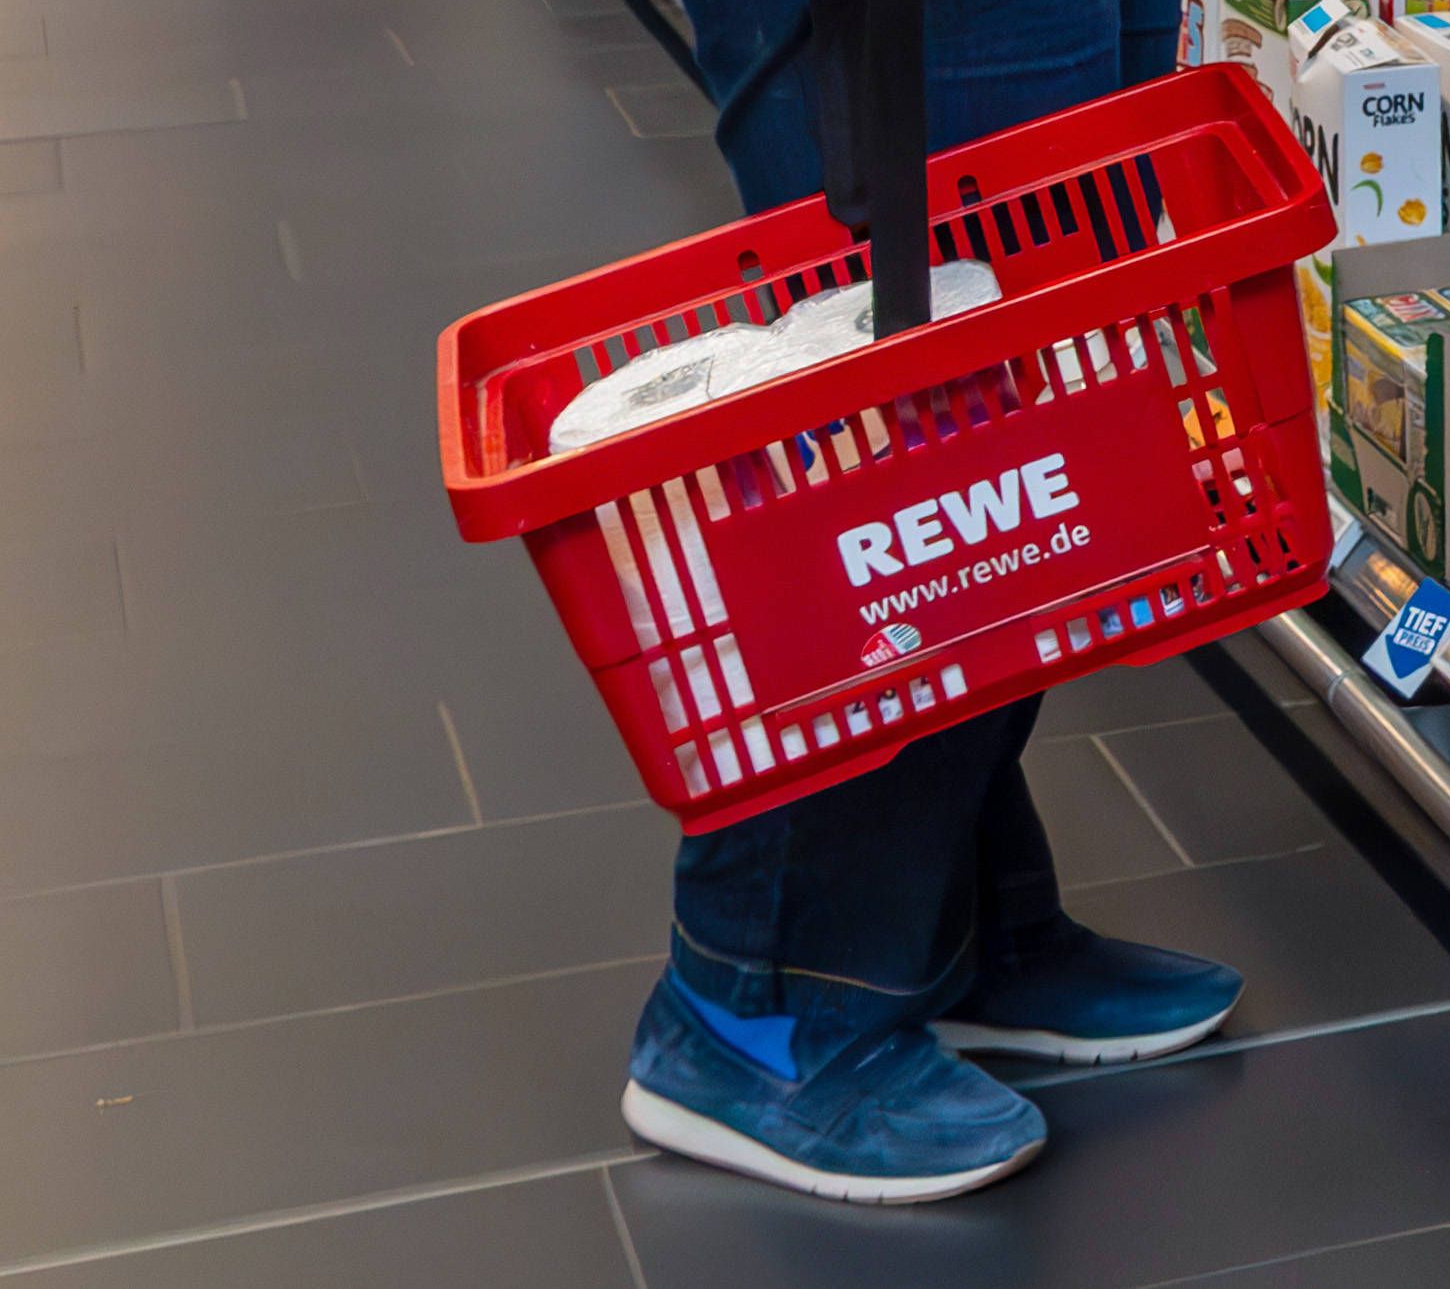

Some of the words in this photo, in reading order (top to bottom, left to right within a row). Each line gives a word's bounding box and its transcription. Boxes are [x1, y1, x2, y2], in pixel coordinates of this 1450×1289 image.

[1361, 90, 1425, 119] CORN
[1372, 112, 1416, 129] Flakes
[834, 451, 1081, 591] REWE
[859, 519, 1092, 628] www.rewe.de
